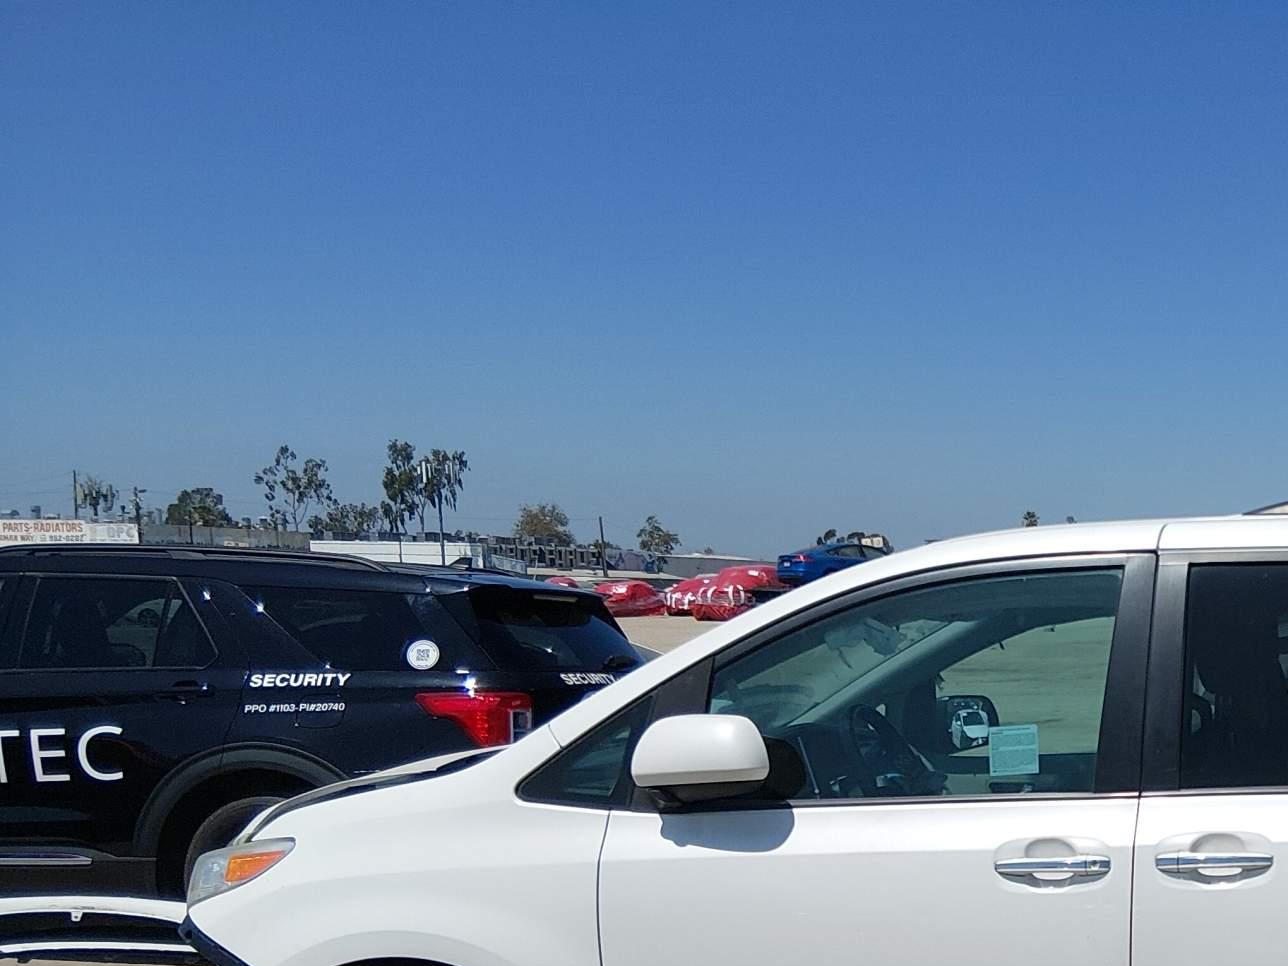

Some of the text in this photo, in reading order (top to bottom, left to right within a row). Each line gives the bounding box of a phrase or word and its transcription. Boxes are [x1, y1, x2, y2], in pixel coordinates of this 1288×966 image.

[2, 522, 83, 532] PARTS-RADIATORS
[249, 673, 352, 688] SECURITY
[559, 672, 617, 686] SECURITY
[244, 704, 267, 713] PPO
